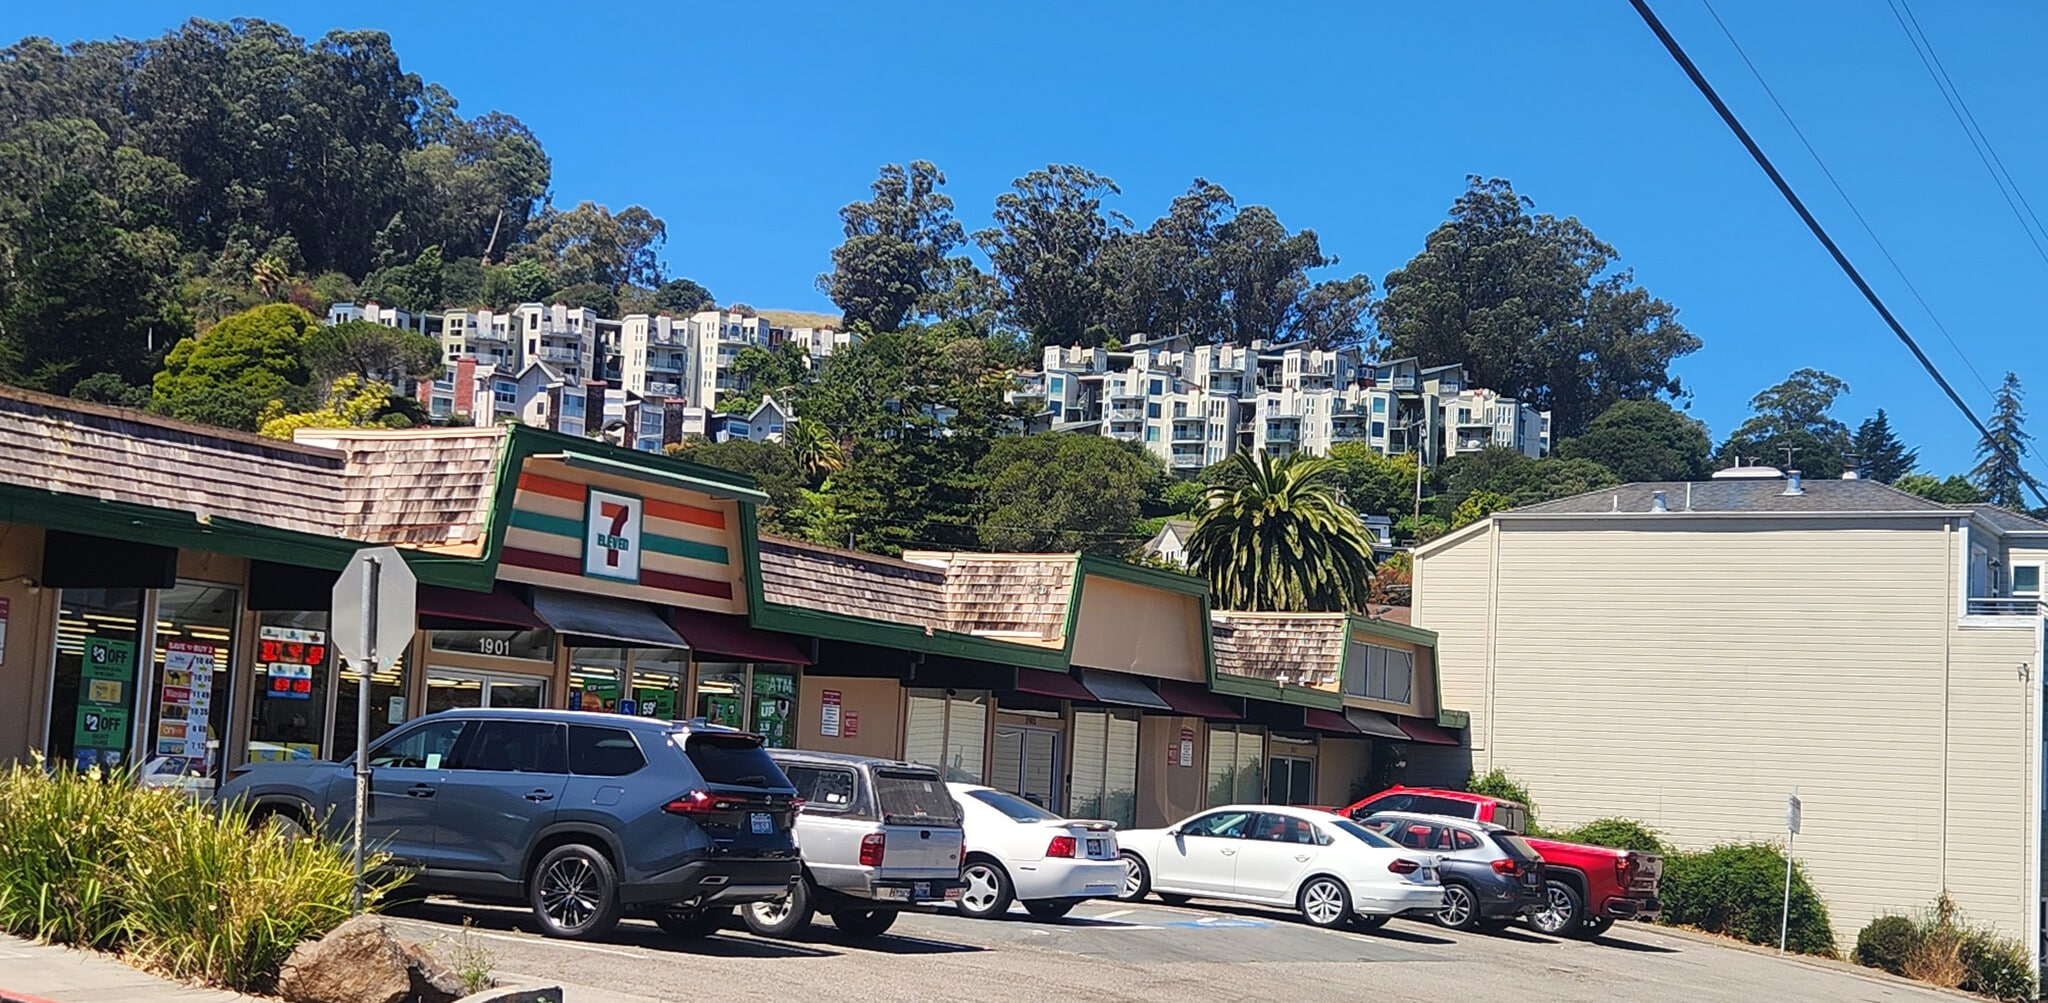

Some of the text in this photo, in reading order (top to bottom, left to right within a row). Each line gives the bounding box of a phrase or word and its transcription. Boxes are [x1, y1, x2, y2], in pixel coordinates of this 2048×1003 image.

[601, 502, 629, 567] 7
[93, 646, 128, 663] $3 OFF
[479, 637, 509, 655] 1901
[769, 677, 792, 693] ATM
[761, 706, 775, 717] UP
[86, 714, 121, 731] $2 OFF
